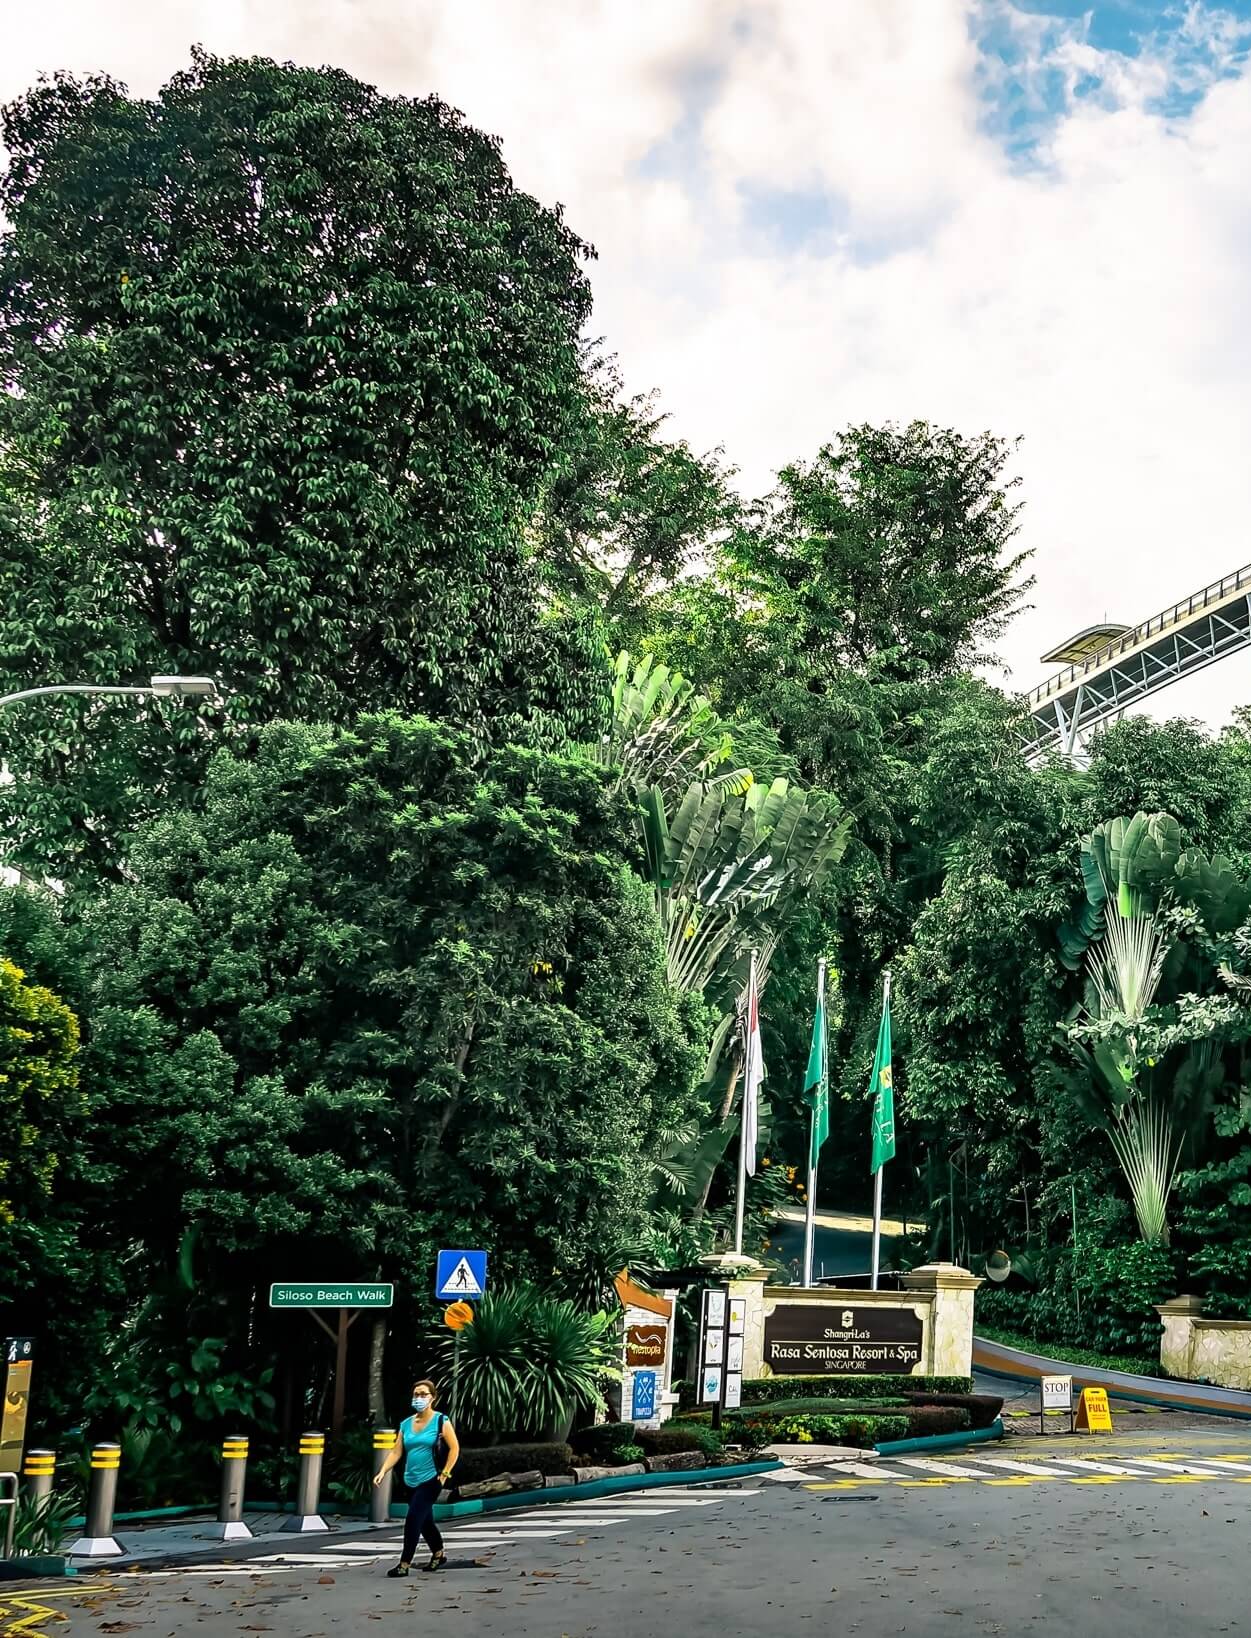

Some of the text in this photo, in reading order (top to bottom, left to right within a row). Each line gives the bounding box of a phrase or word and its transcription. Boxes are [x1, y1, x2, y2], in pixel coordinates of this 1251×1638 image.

[277, 1290, 386, 1300] Siloso Beach Walk
[770, 1344, 801, 1359] Rasa
[803, 1344, 850, 1360] Sentosa
[852, 1345, 888, 1360] Resort
[896, 1346, 918, 1363] Spa
[824, 1360, 867, 1370] SINGAPORE
[1044, 1382, 1069, 1393] STOP
[1088, 1403, 1107, 1413] FULL
